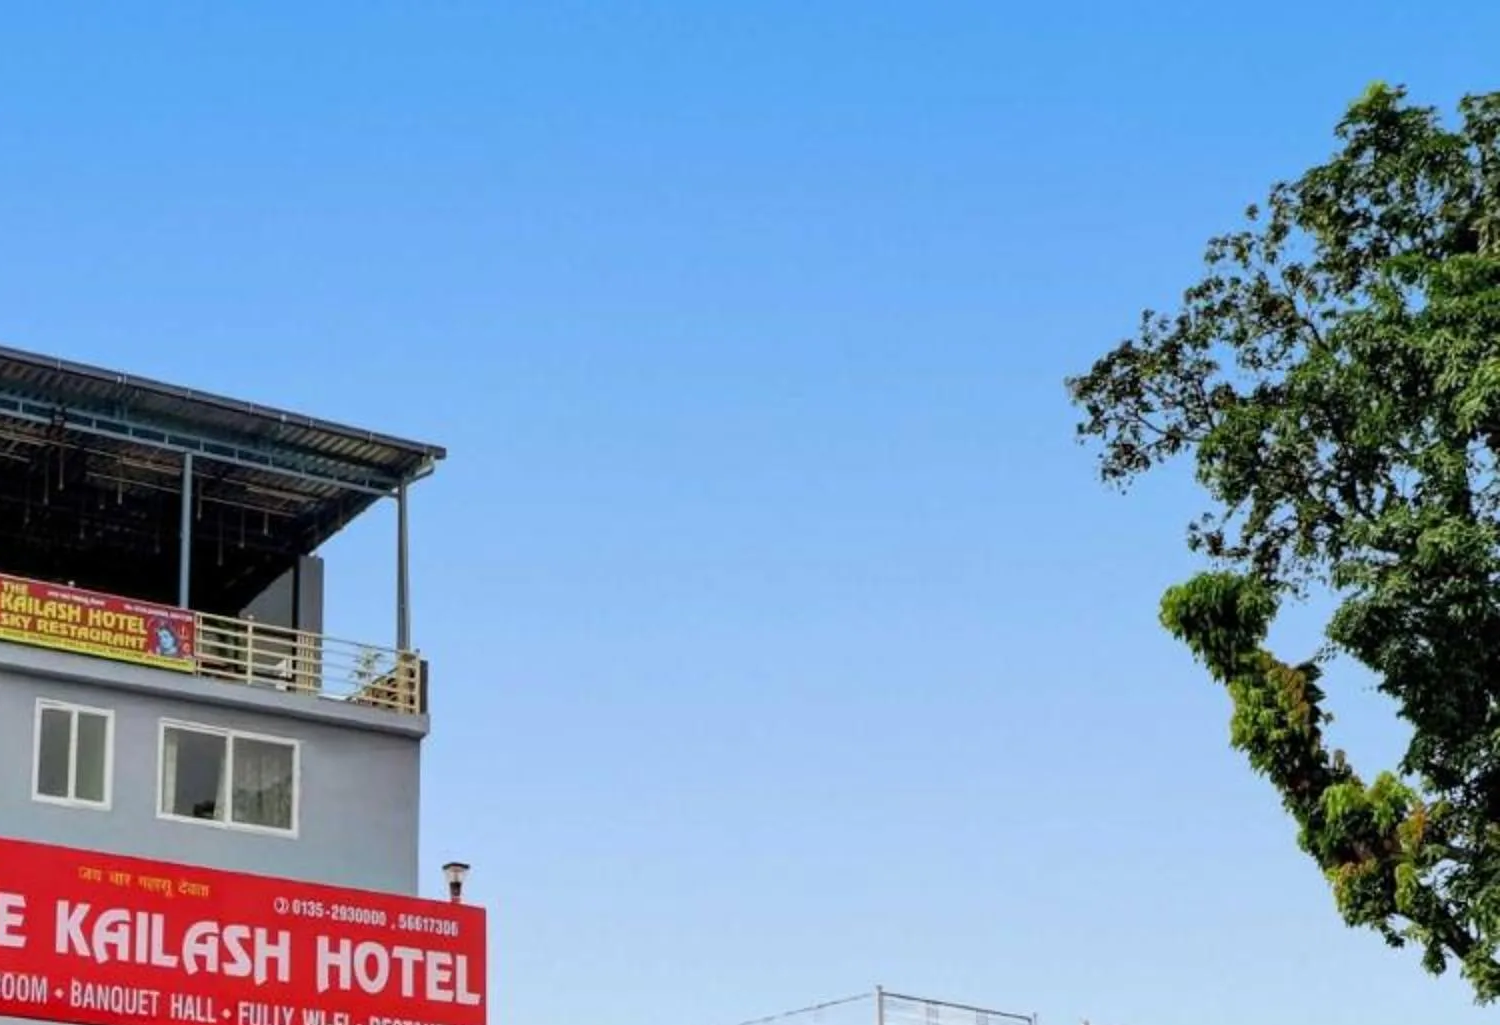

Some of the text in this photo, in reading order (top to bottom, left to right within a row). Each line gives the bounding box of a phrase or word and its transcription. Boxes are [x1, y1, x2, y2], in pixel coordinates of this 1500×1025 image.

[3, 581, 28, 597] THE
[0, 591, 81, 623] KAILASH
[88, 607, 148, 635] HOTEL
[0, 613, 30, 632] SKY
[55, 899, 291, 986] KAILASH
[316, 935, 481, 1005] HOTEL
[71, 978, 160, 1017] BANQUET
[170, 992, 217, 1023] HALL
